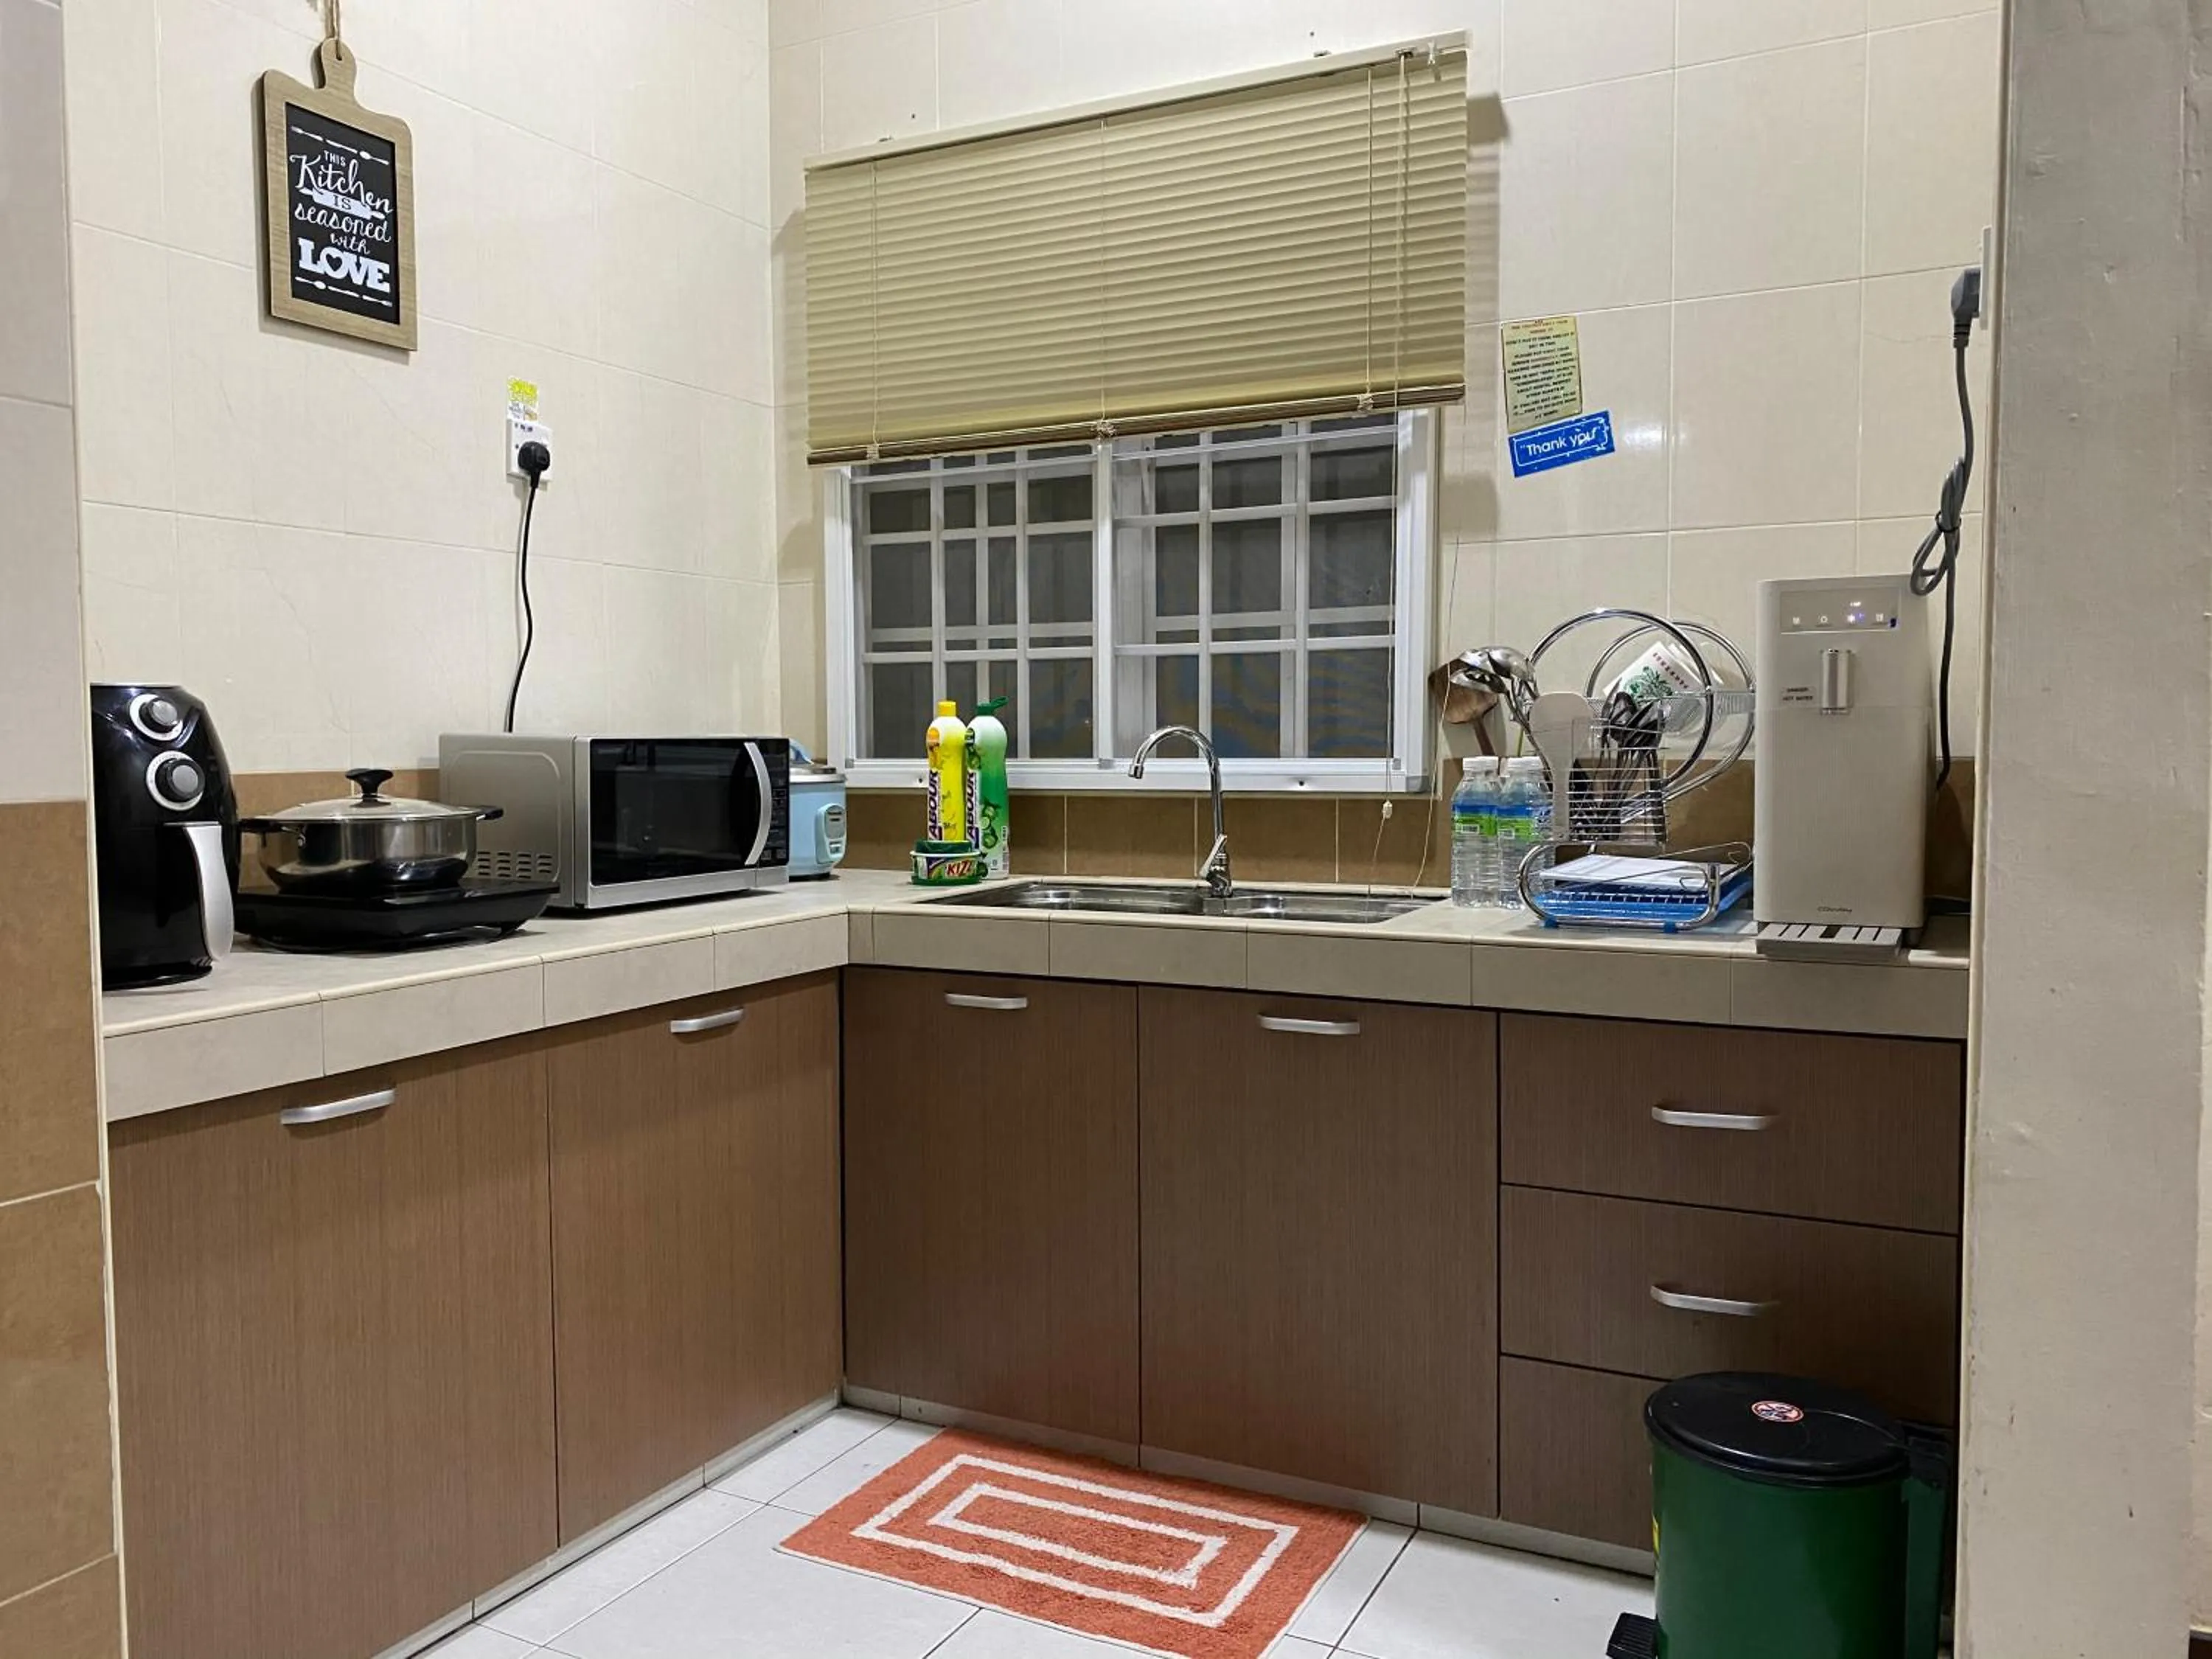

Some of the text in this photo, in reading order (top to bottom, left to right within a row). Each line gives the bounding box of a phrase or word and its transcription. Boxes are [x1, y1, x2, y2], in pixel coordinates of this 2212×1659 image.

[324, 150, 346, 167] THIS
[290, 154, 393, 213] Kitchen
[333, 195, 352, 210] IS
[295, 203, 392, 243] seasoned
[330, 233, 371, 254] with
[298, 237, 390, 293] LOVE
[928, 770, 938, 841] ABOUR
